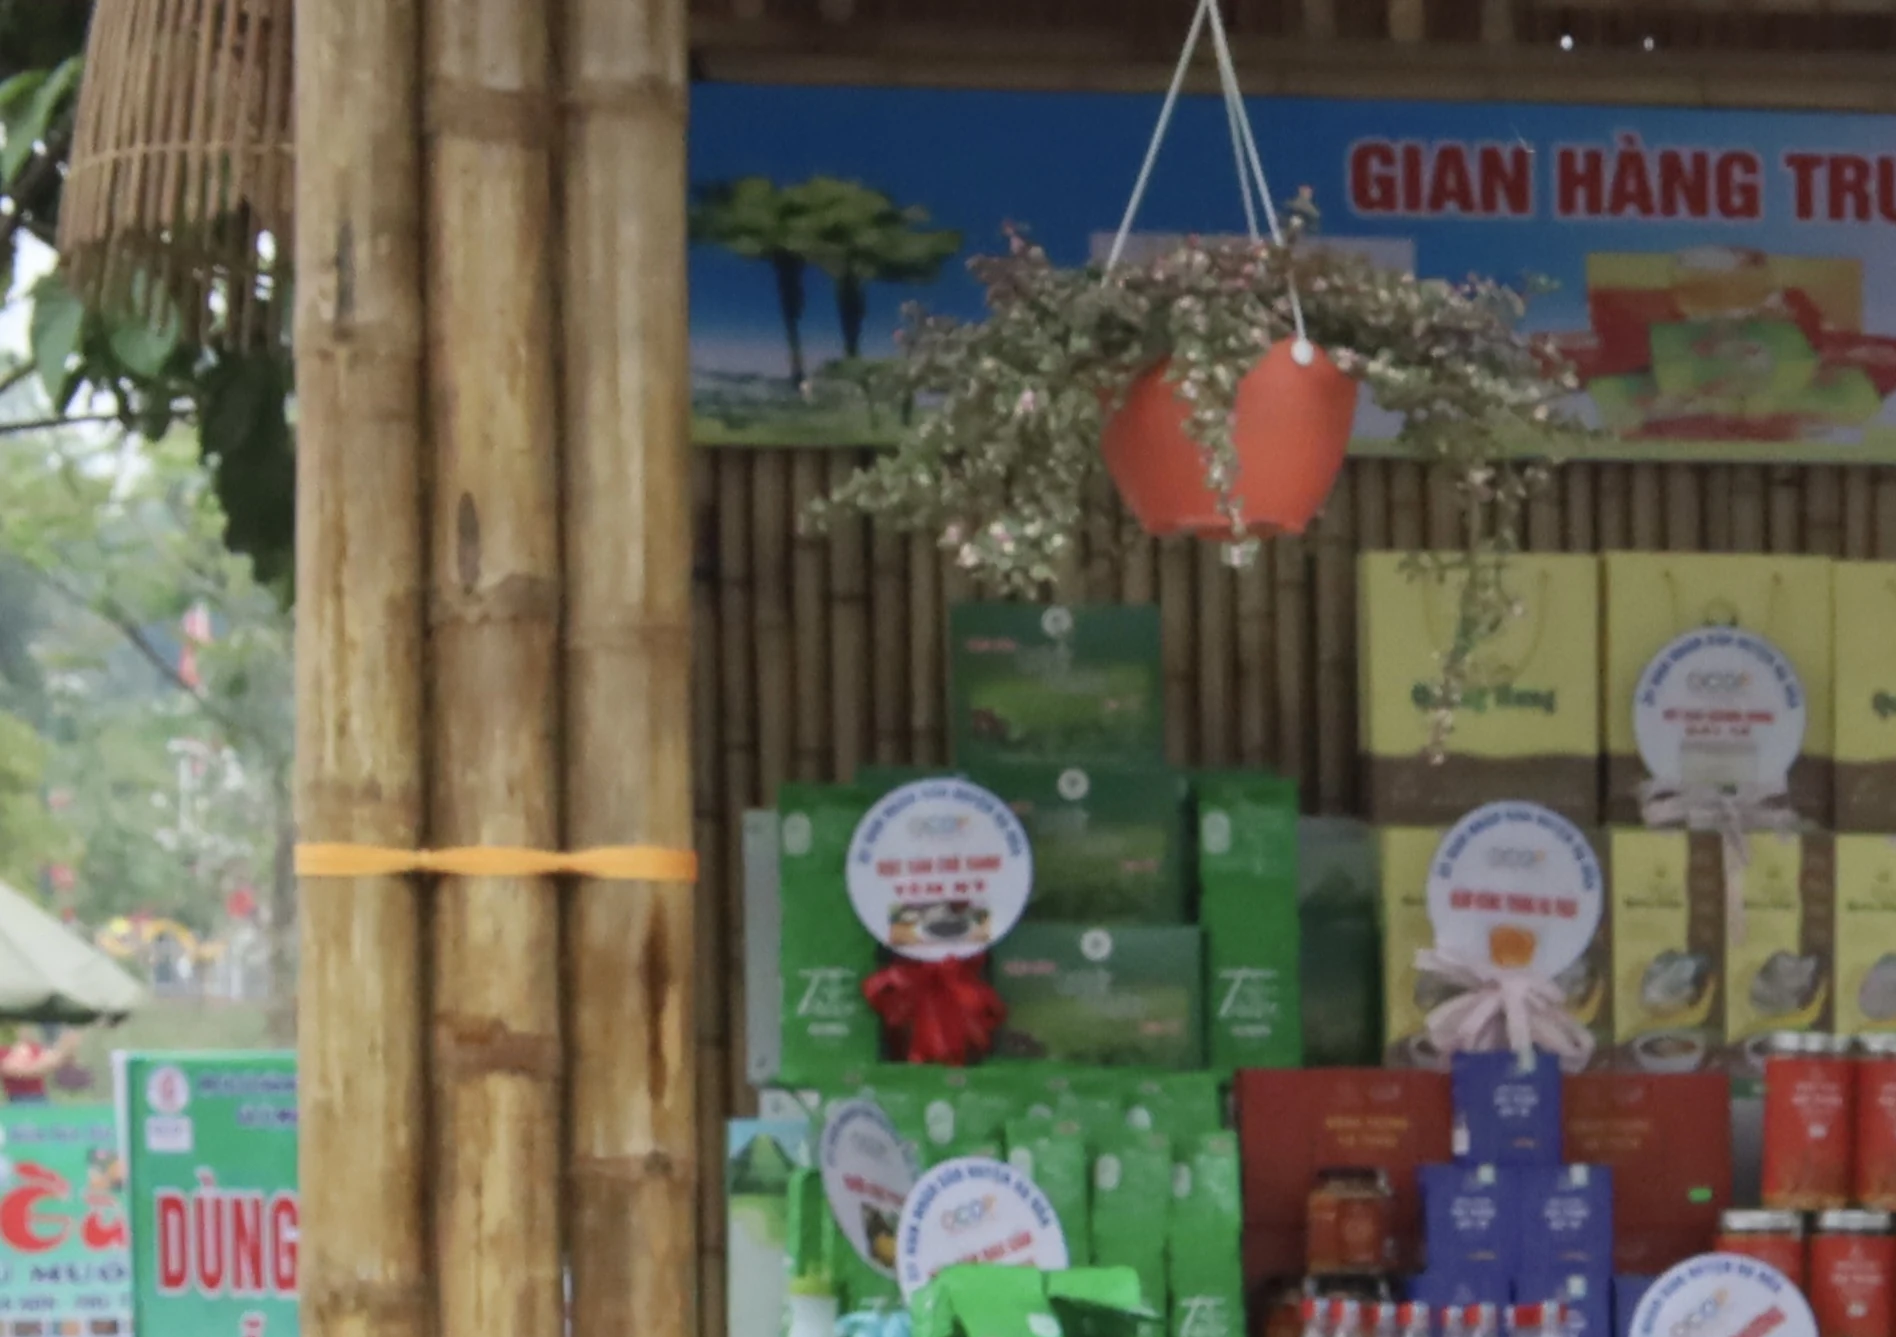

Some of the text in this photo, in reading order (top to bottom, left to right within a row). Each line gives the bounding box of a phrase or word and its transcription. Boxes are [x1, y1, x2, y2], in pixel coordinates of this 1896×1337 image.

[1351, 143, 1530, 215] GIAN
[1557, 135, 1761, 219] HÀNG
[156, 1167, 299, 1292] DÙNG
